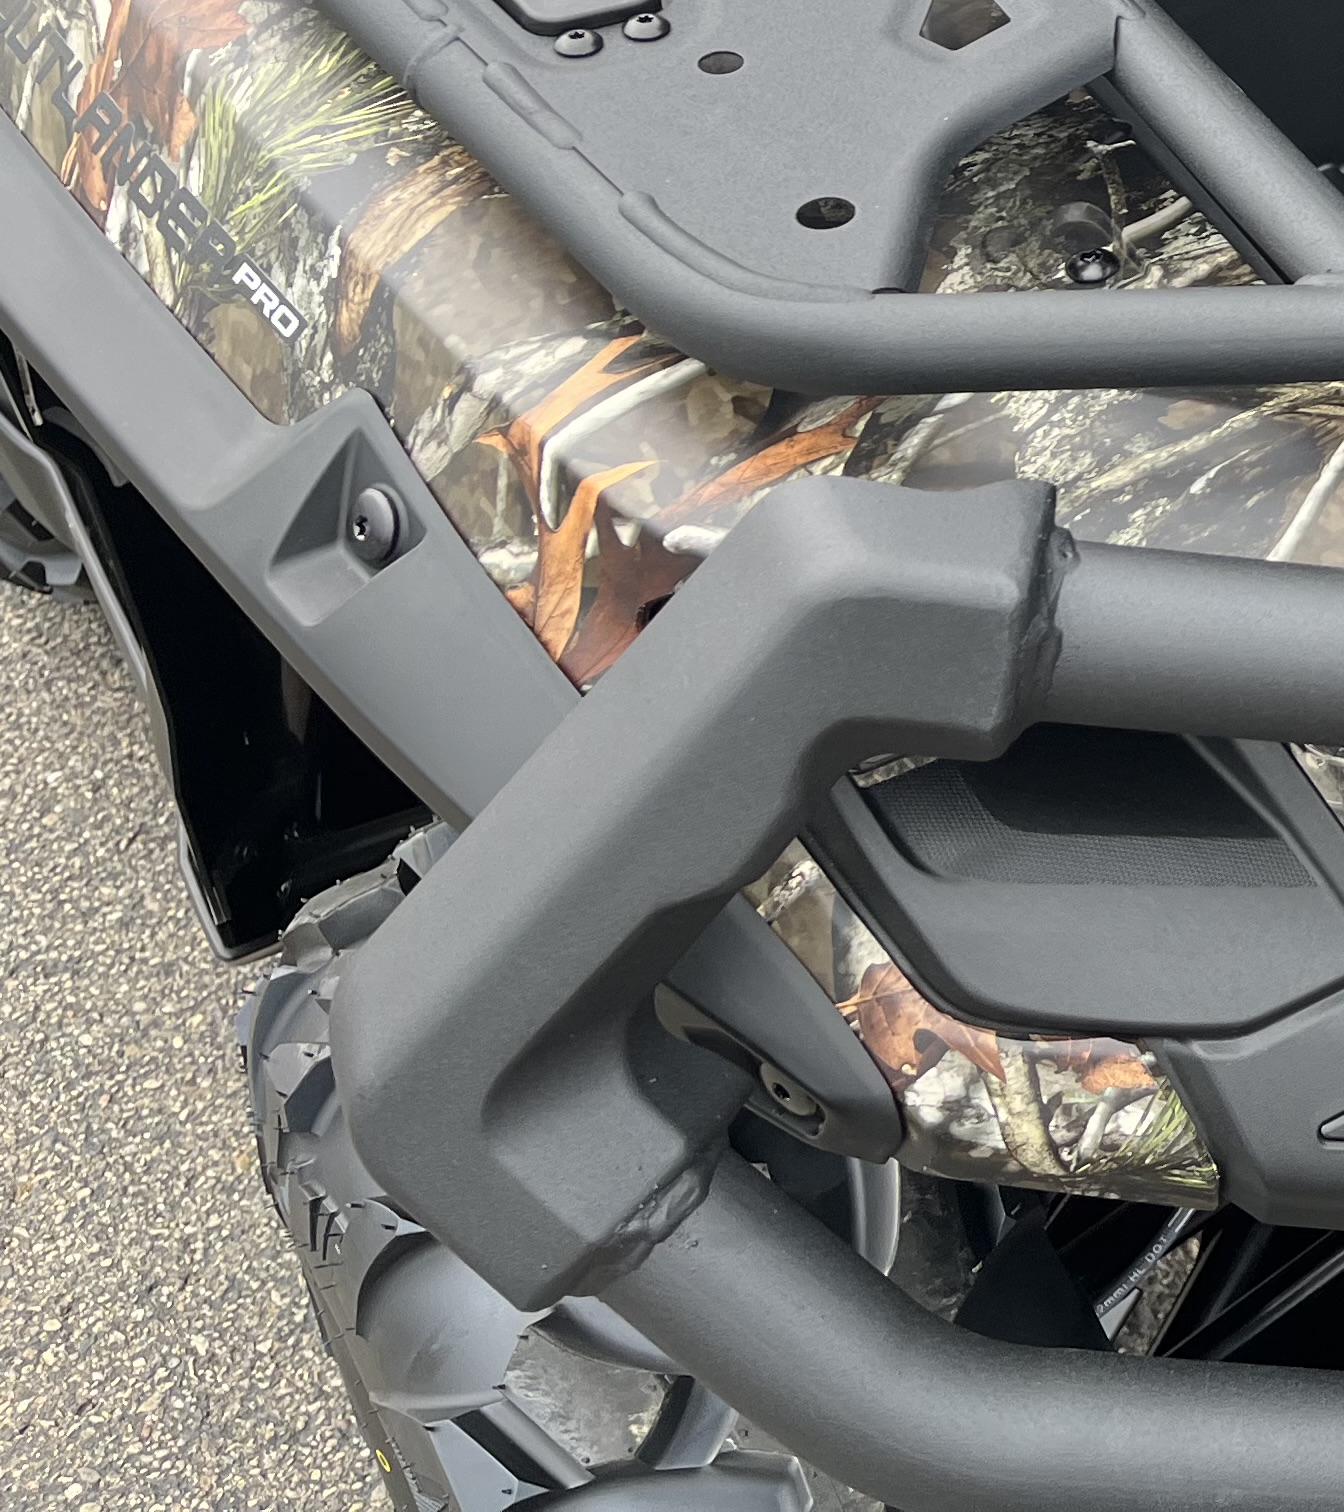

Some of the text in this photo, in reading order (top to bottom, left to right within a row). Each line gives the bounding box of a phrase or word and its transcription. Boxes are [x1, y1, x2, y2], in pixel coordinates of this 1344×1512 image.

[232, 262, 301, 339] PRO
[1128, 1267, 1146, 1282] HL
[1144, 1235, 1168, 1263] DOT
